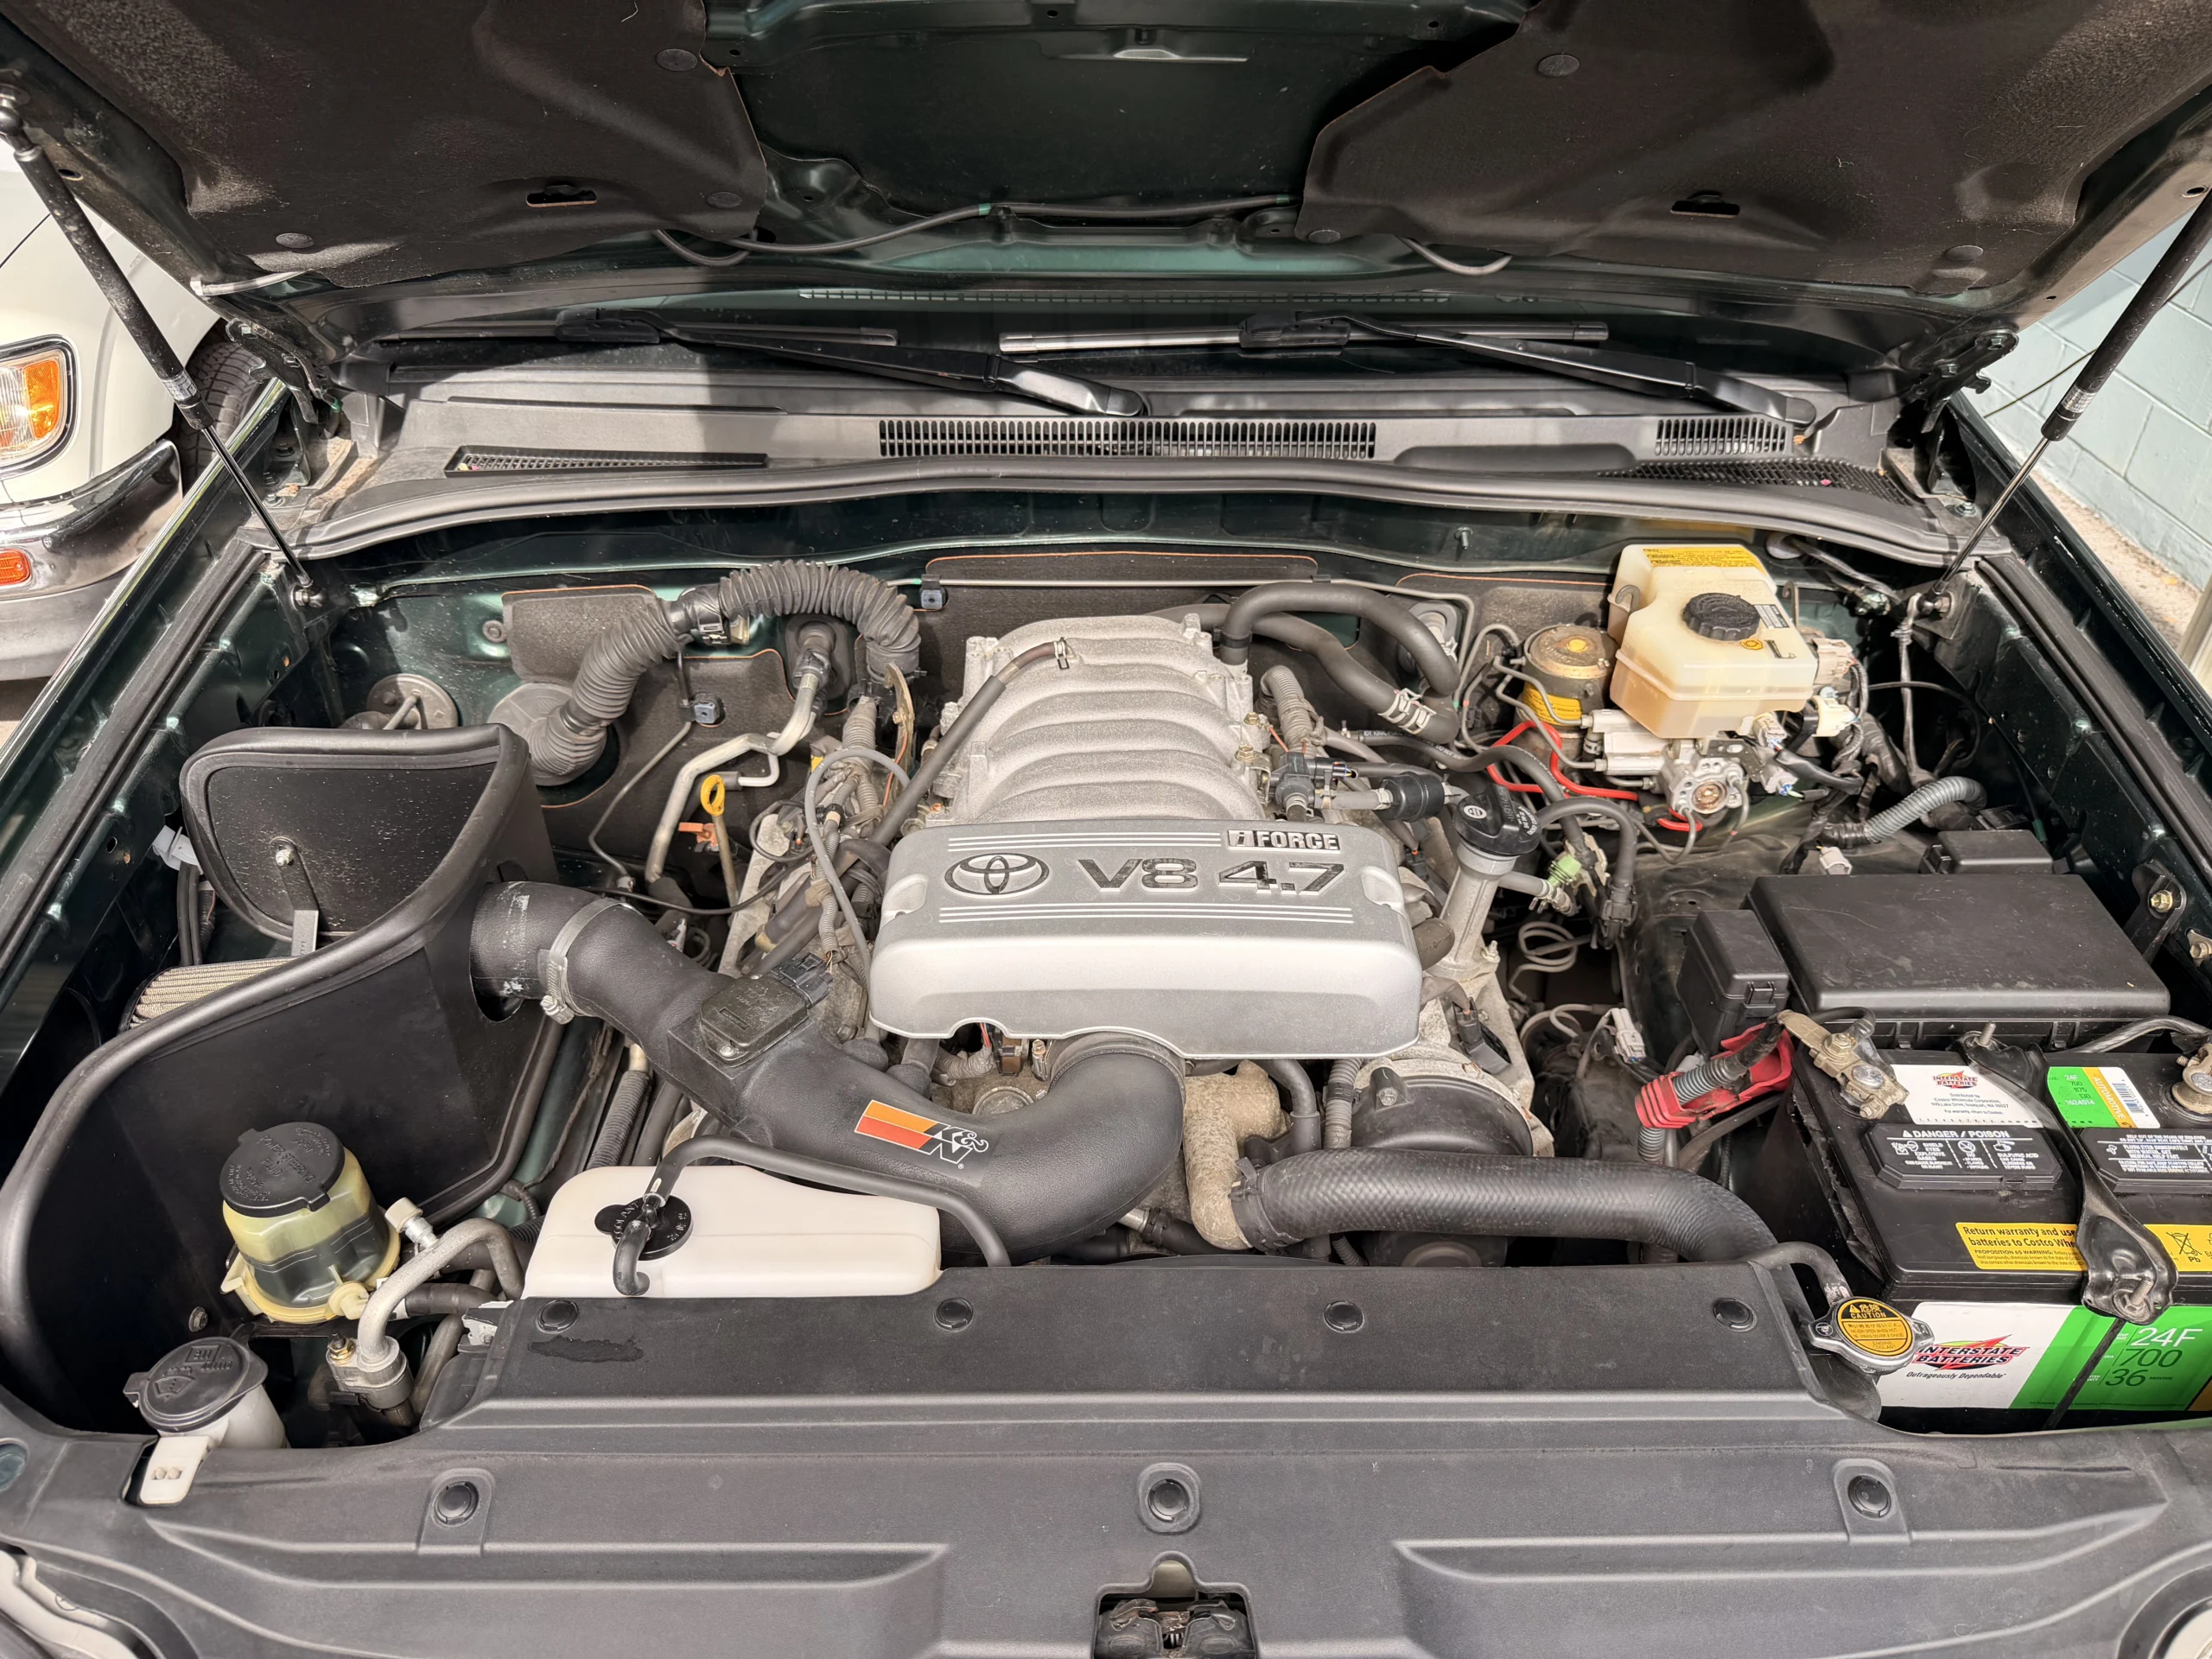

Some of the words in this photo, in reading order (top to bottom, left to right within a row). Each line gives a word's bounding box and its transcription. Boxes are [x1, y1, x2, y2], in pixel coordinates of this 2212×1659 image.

[1077, 858, 1199, 891] V8
[1218, 861, 1344, 894] 4.7
[2092, 1077, 2126, 1120] AUTOMOTIVE
[259, 1135, 286, 1156] POWER
[281, 1153, 316, 1184] STEERING
[261, 1158, 283, 1177] FLUID
[1963, 1227, 1995, 1236] Return
[1997, 1228, 2039, 1236] warranty
[1968, 1237, 2012, 1246] batteries
[2024, 1238, 2054, 1247] Costco
[1859, 1304, 1881, 1313] 危険
[2130, 1327, 2203, 1347] 24F
[1916, 1355, 2010, 1363] BATTERIES
[1918, 1346, 2024, 1355] INTERSTATE
[2119, 1348, 2183, 1368] 700
[2105, 1369, 2149, 1387] 36
